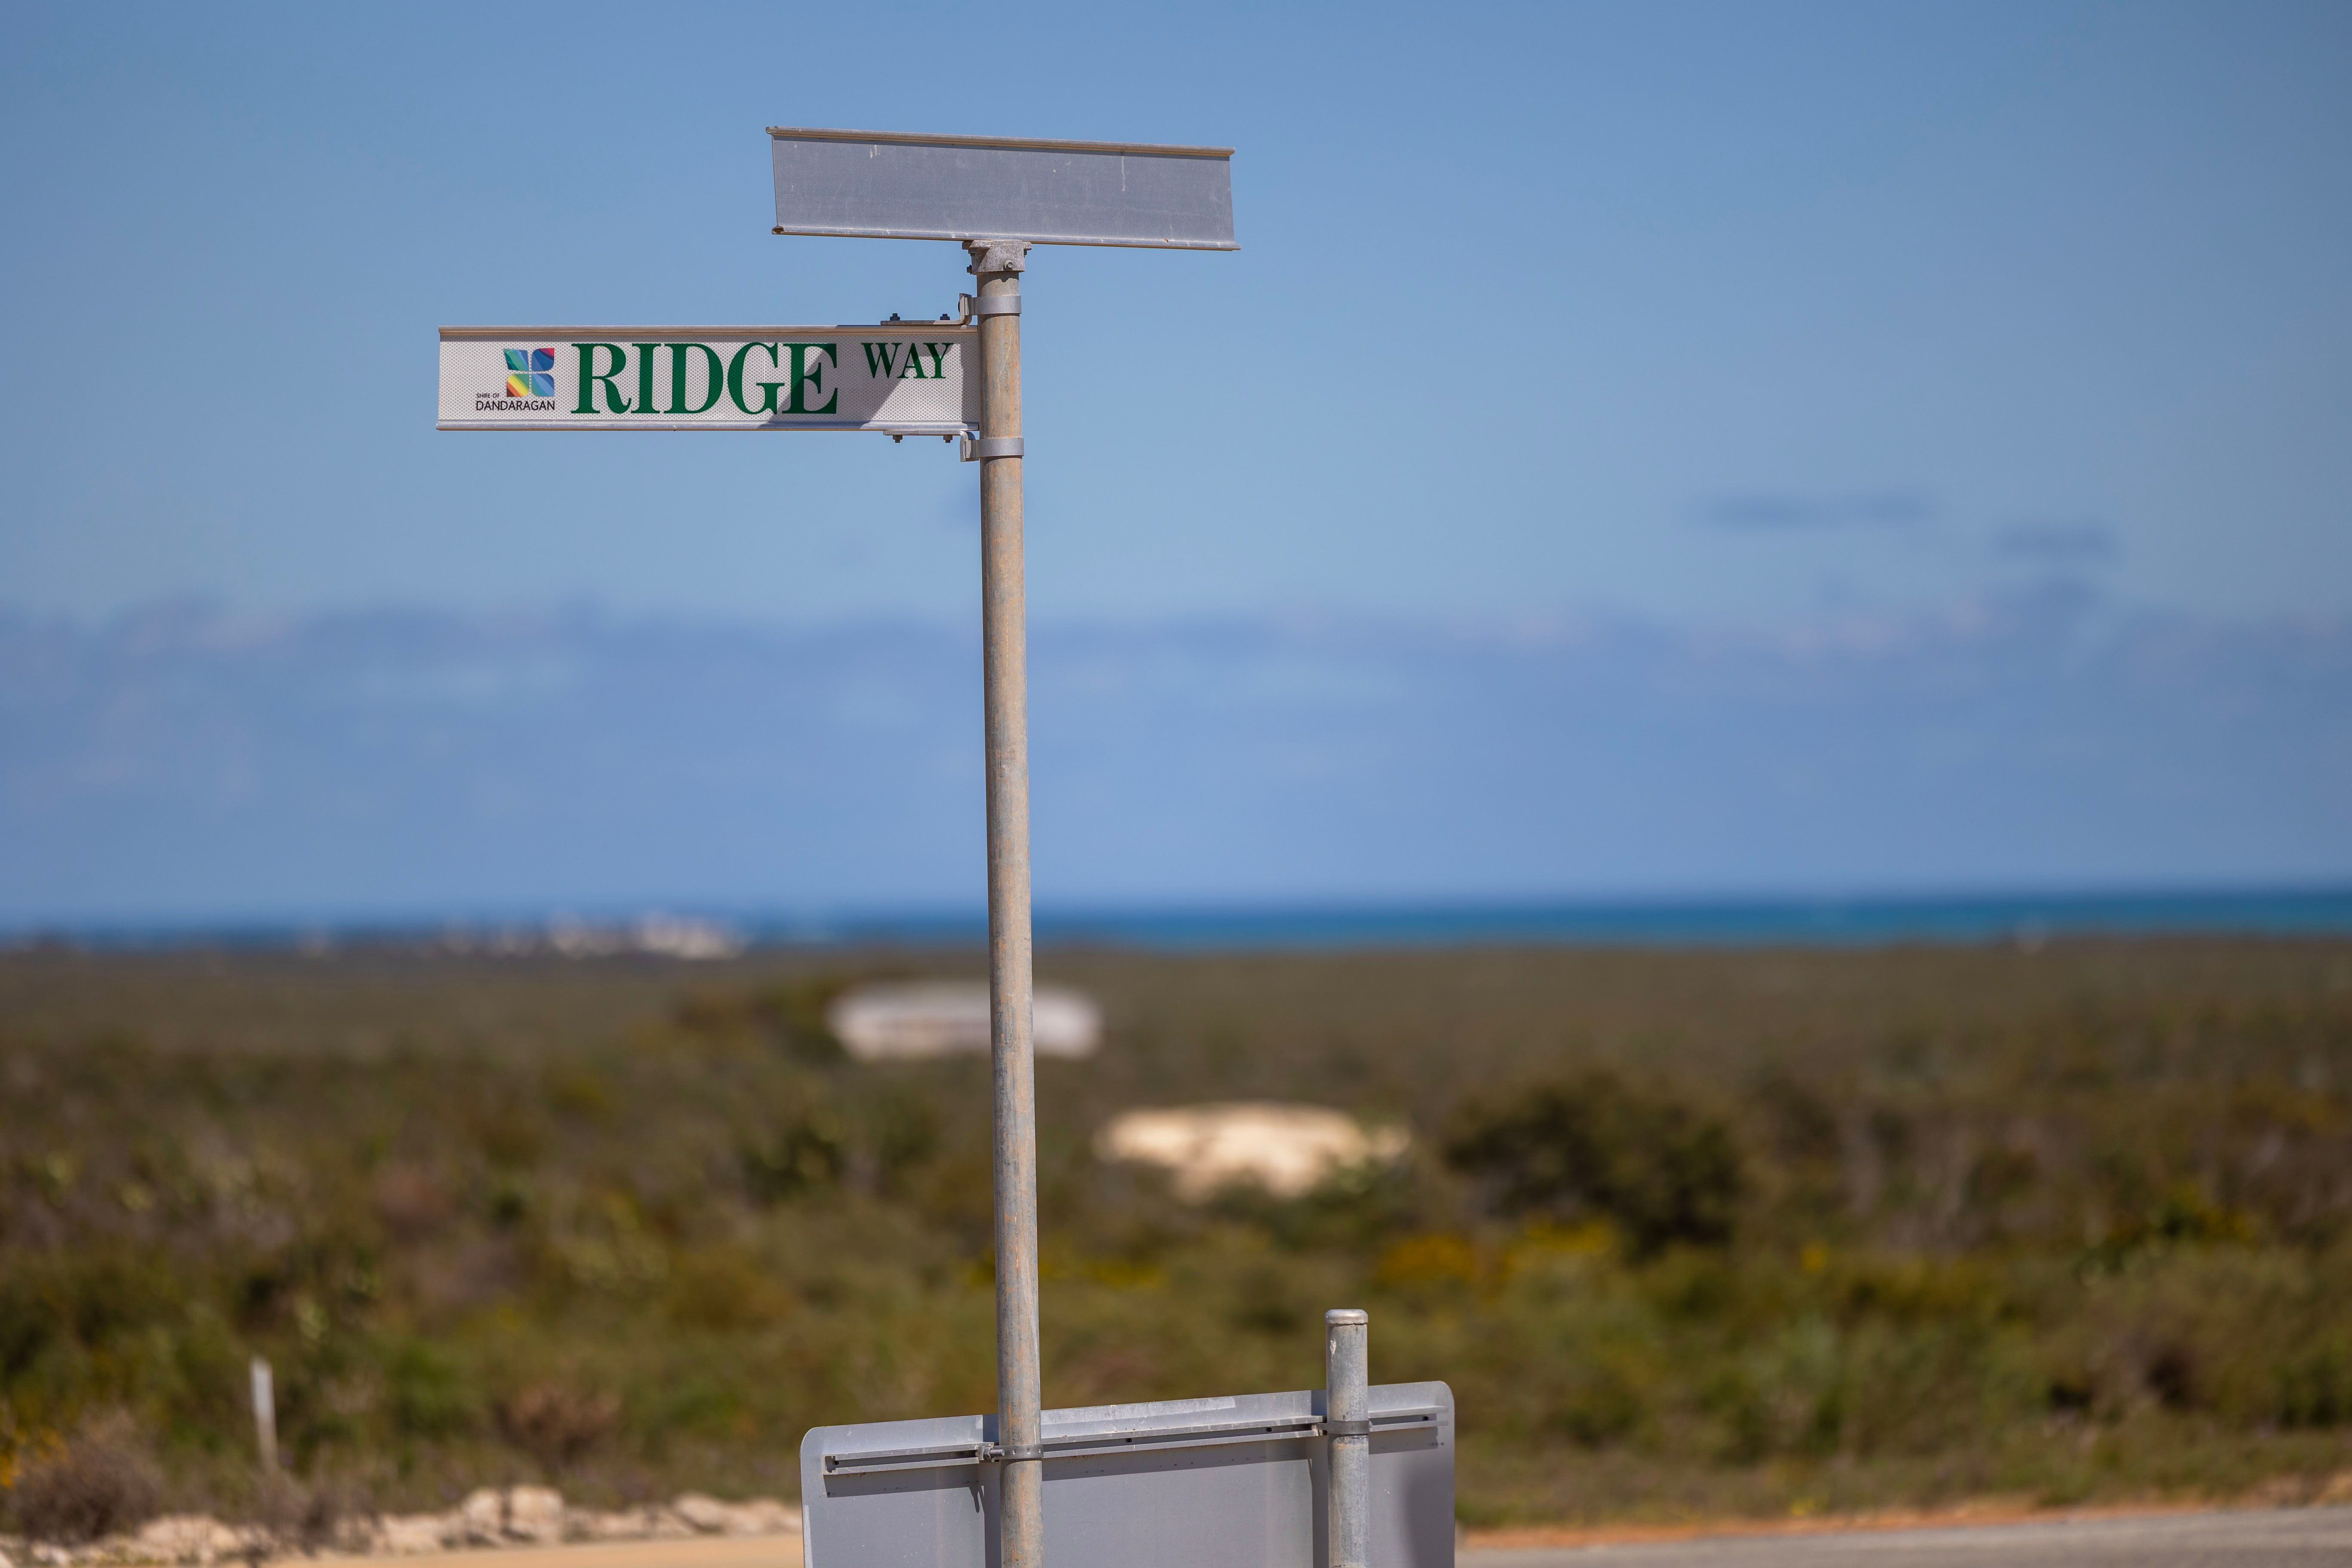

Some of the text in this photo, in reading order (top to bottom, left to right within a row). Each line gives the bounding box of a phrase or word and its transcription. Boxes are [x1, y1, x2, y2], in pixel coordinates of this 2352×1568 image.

[571, 342, 954, 415] RIDGE WAY
[475, 400, 555, 410] DANDARAGAN
